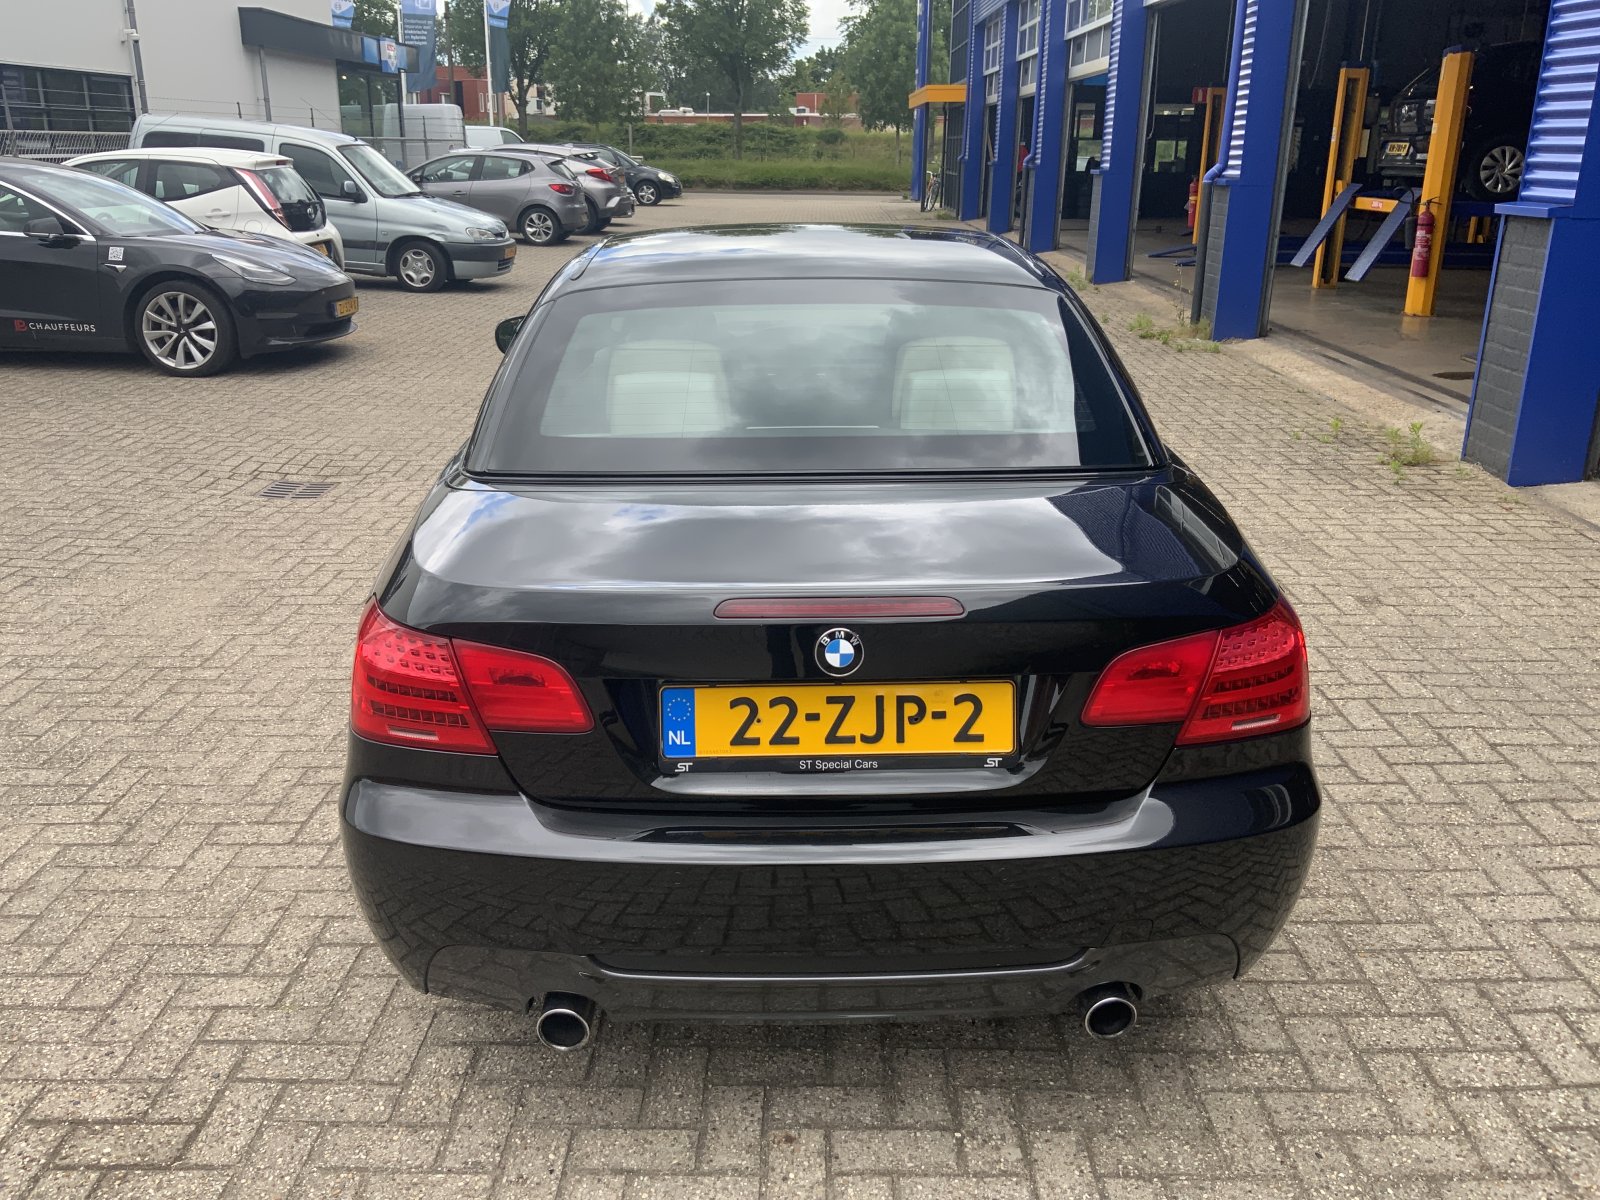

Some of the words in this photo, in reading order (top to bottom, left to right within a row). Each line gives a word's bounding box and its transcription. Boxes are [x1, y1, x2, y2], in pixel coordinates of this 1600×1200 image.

[29, 322, 96, 332] CHAUFFEURS
[820, 630, 860, 647] BMW
[668, 730, 691, 745] NL
[728, 692, 985, 746] 22-ZJP-2
[799, 759, 813, 769] ST
[815, 759, 852, 771] Special
[854, 759, 878, 769] Cars
